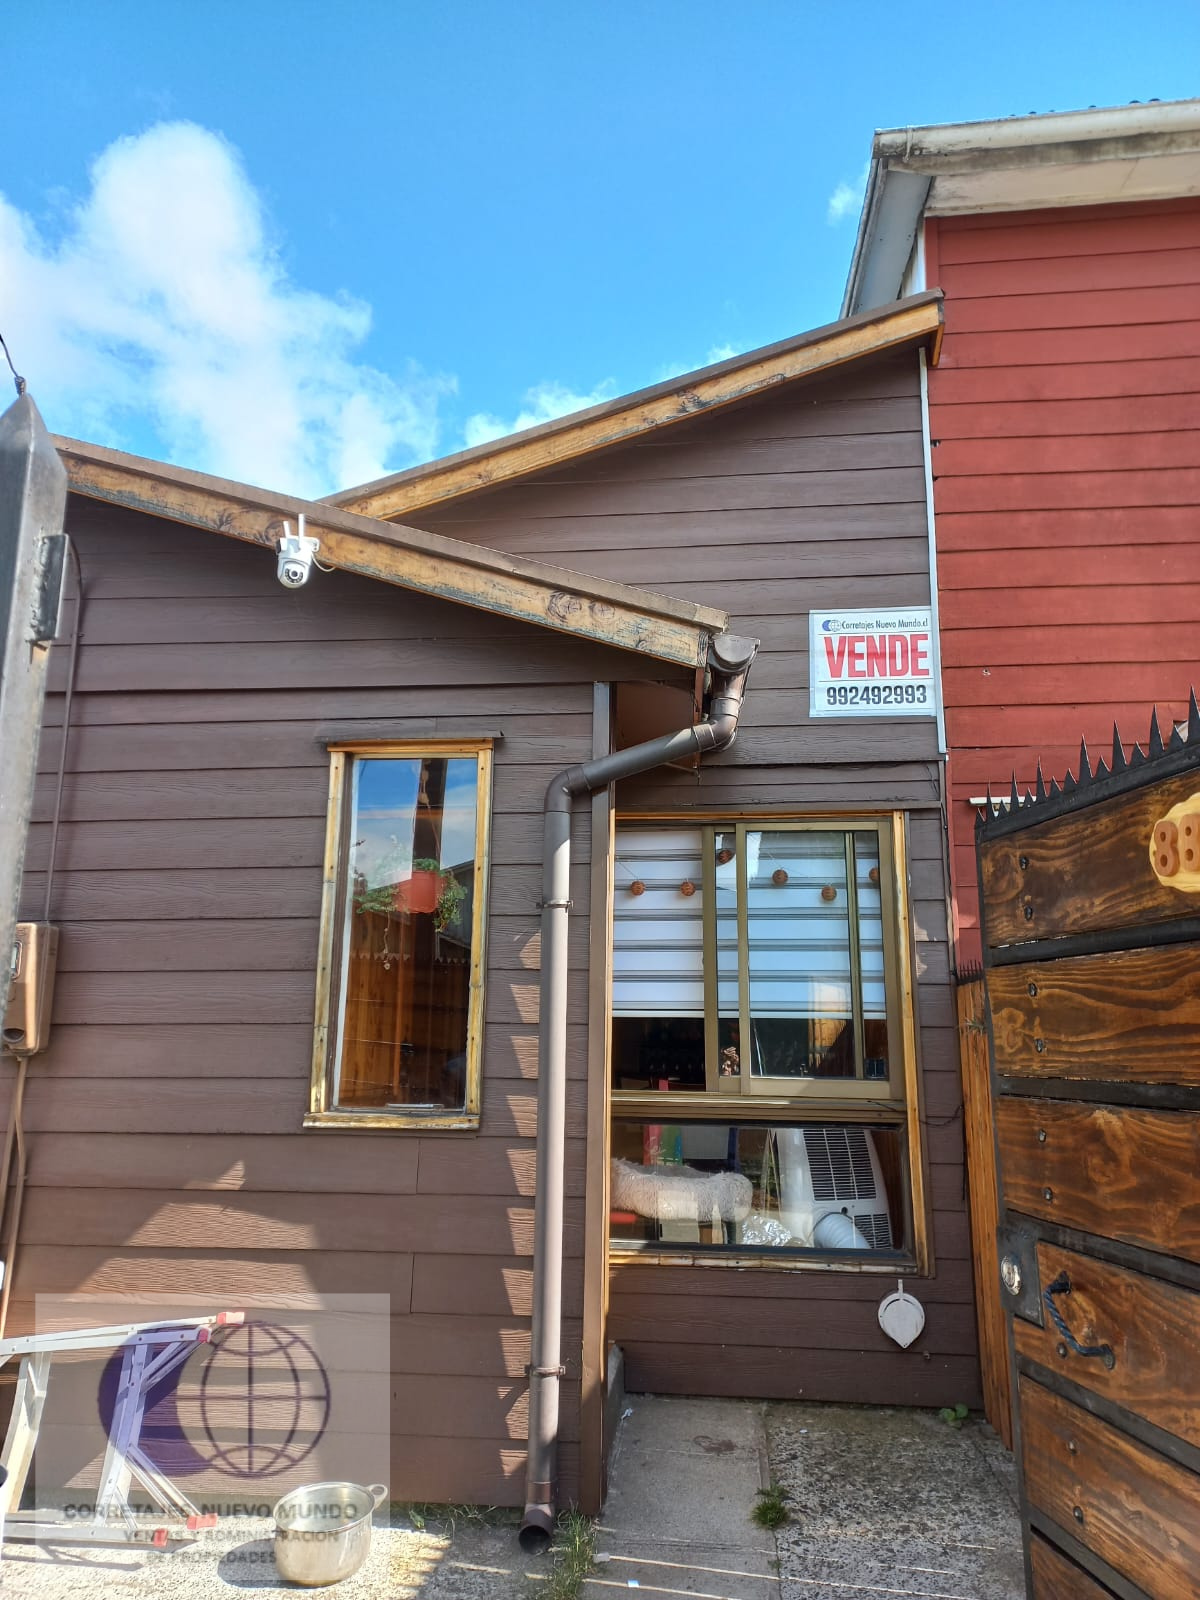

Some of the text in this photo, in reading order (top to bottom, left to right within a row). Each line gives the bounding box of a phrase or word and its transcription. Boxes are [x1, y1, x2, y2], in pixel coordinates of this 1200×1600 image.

[841, 618, 928, 631] Corretajes Nuevo Mundo.cl
[823, 633, 930, 678] VENDE
[826, 684, 927, 706] 992492993
